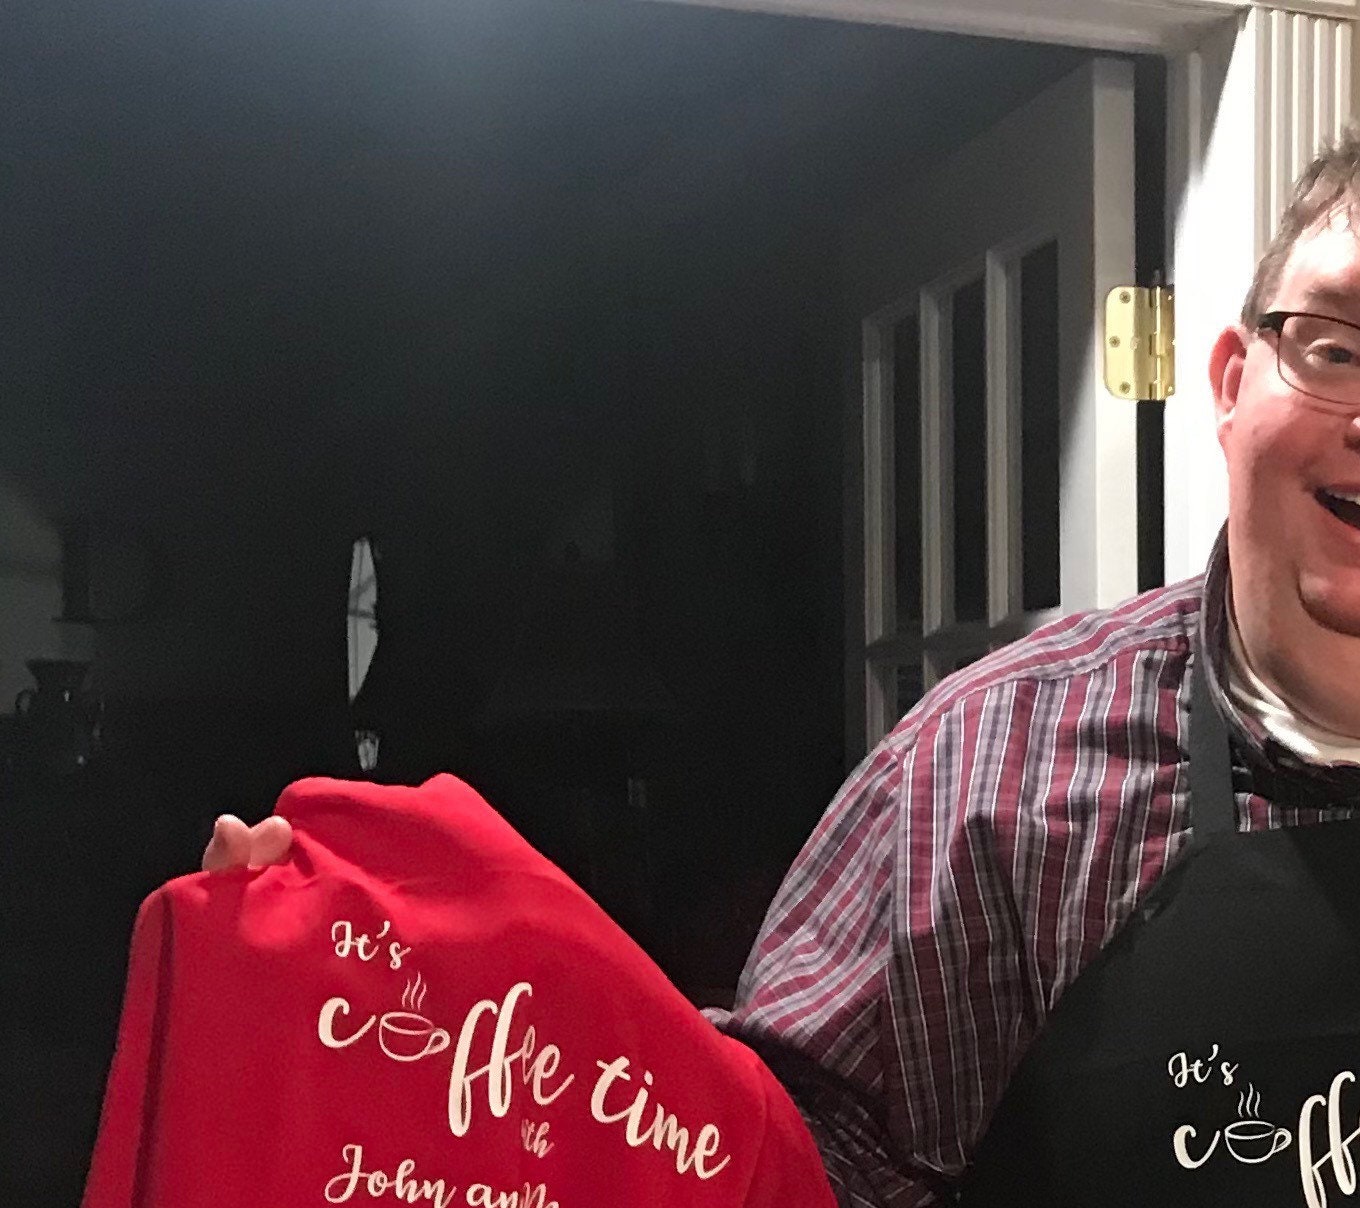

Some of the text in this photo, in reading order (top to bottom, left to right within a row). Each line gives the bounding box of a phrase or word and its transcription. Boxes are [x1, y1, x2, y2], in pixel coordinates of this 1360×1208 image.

[331, 920, 411, 969] It's
[1167, 1043, 1239, 1087] It's
[590, 1055, 730, 1180] time
